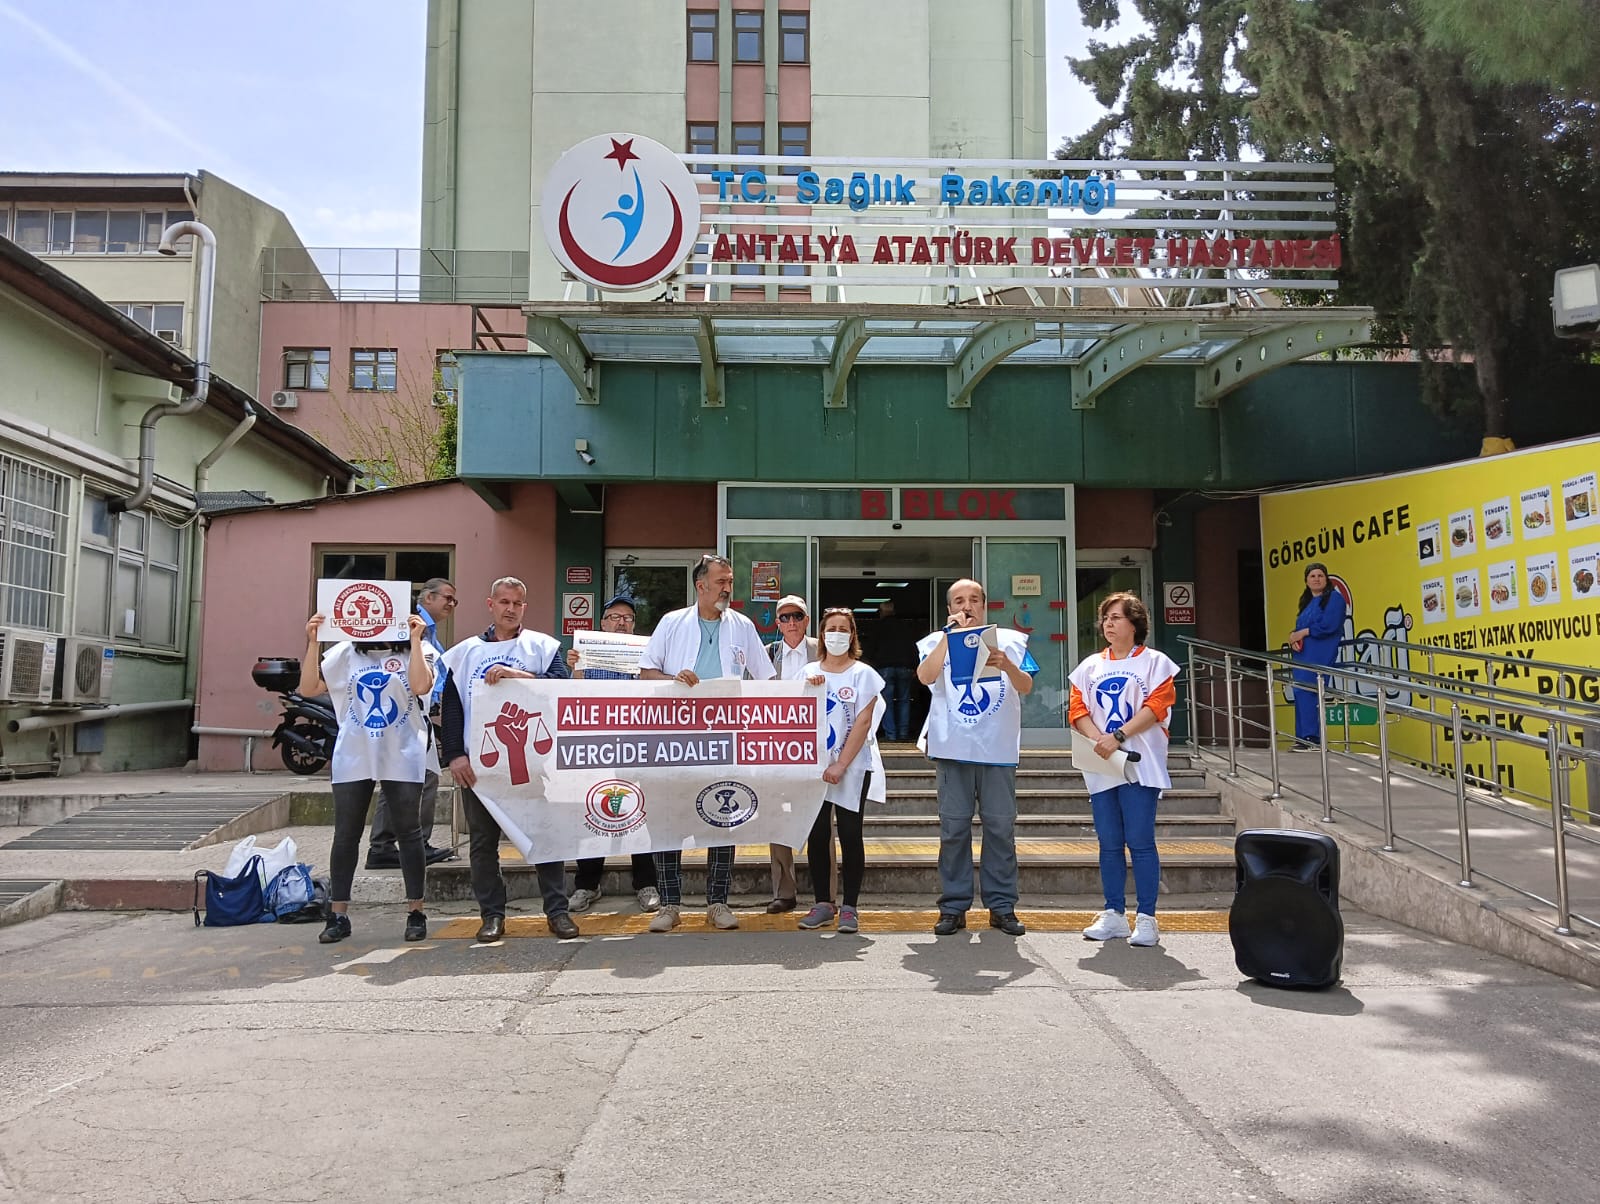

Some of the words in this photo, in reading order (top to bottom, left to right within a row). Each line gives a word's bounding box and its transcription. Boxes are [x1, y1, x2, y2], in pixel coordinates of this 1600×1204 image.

[711, 170, 776, 203] T.C.
[797, 171, 916, 212] Sağlık
[941, 174, 1116, 215] Bakanlığı
[712, 233, 859, 264] ANTALYA
[873, 230, 1018, 265] ATATÜRK
[1032, 236, 1155, 267] DEVLET
[1167, 233, 1342, 268] HASTANESİ
[861, 489, 887, 519] B
[903, 489, 1018, 519] BLOK
[1269, 526, 1345, 568] GÖRGÜN
[1352, 504, 1411, 544] CAFE
[333, 618, 365, 626] VERGİDE
[1454, 625, 1477, 650] BEZİ
[1480, 623, 1516, 648] YATAK
[1519, 614, 1591, 644] KORUYUCU
[561, 700, 600, 725] AİLE
[606, 699, 697, 725] HEKİMLİĞİ
[702, 704, 813, 730] ÇALIŞANLARI
[560, 737, 648, 766] VERGİDE
[654, 740, 730, 762] ADALET
[741, 736, 815, 761] İSTİYOR
